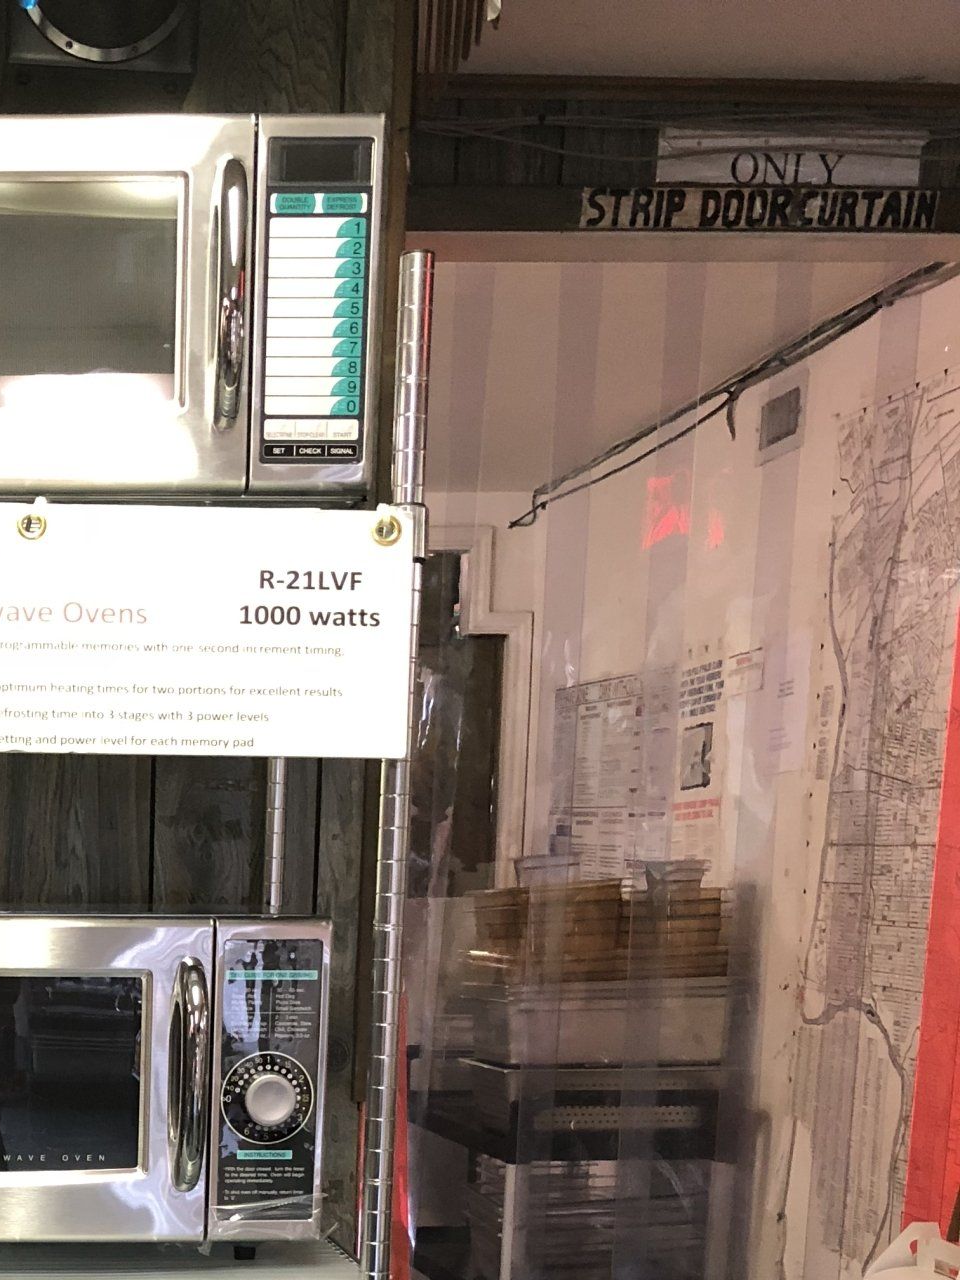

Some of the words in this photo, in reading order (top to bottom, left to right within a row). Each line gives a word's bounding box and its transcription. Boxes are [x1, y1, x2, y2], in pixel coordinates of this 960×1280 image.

[732, 152, 843, 185] ONLY
[586, 189, 686, 228] STRIP
[699, 190, 791, 228] DOOR
[800, 190, 937, 228] CURTAIN
[354, 222, 360, 234] 1
[353, 242, 362, 254] 2
[352, 262, 361, 274] 3
[352, 283, 360, 294] 4
[350, 302, 360, 314] 5
[350, 322, 358, 334] 6
[350, 342, 358, 353] 7
[348, 362, 357, 374] 8
[348, 381, 356, 393] 9
[347, 400, 356, 412] 0
[260, 570, 362, 590] R-21LVF
[62, 601, 148, 625] Ovens
[240, 605, 301, 625] 1000
[309, 609, 380, 627] watts
[62, 1153, 106, 1162] OVEN
